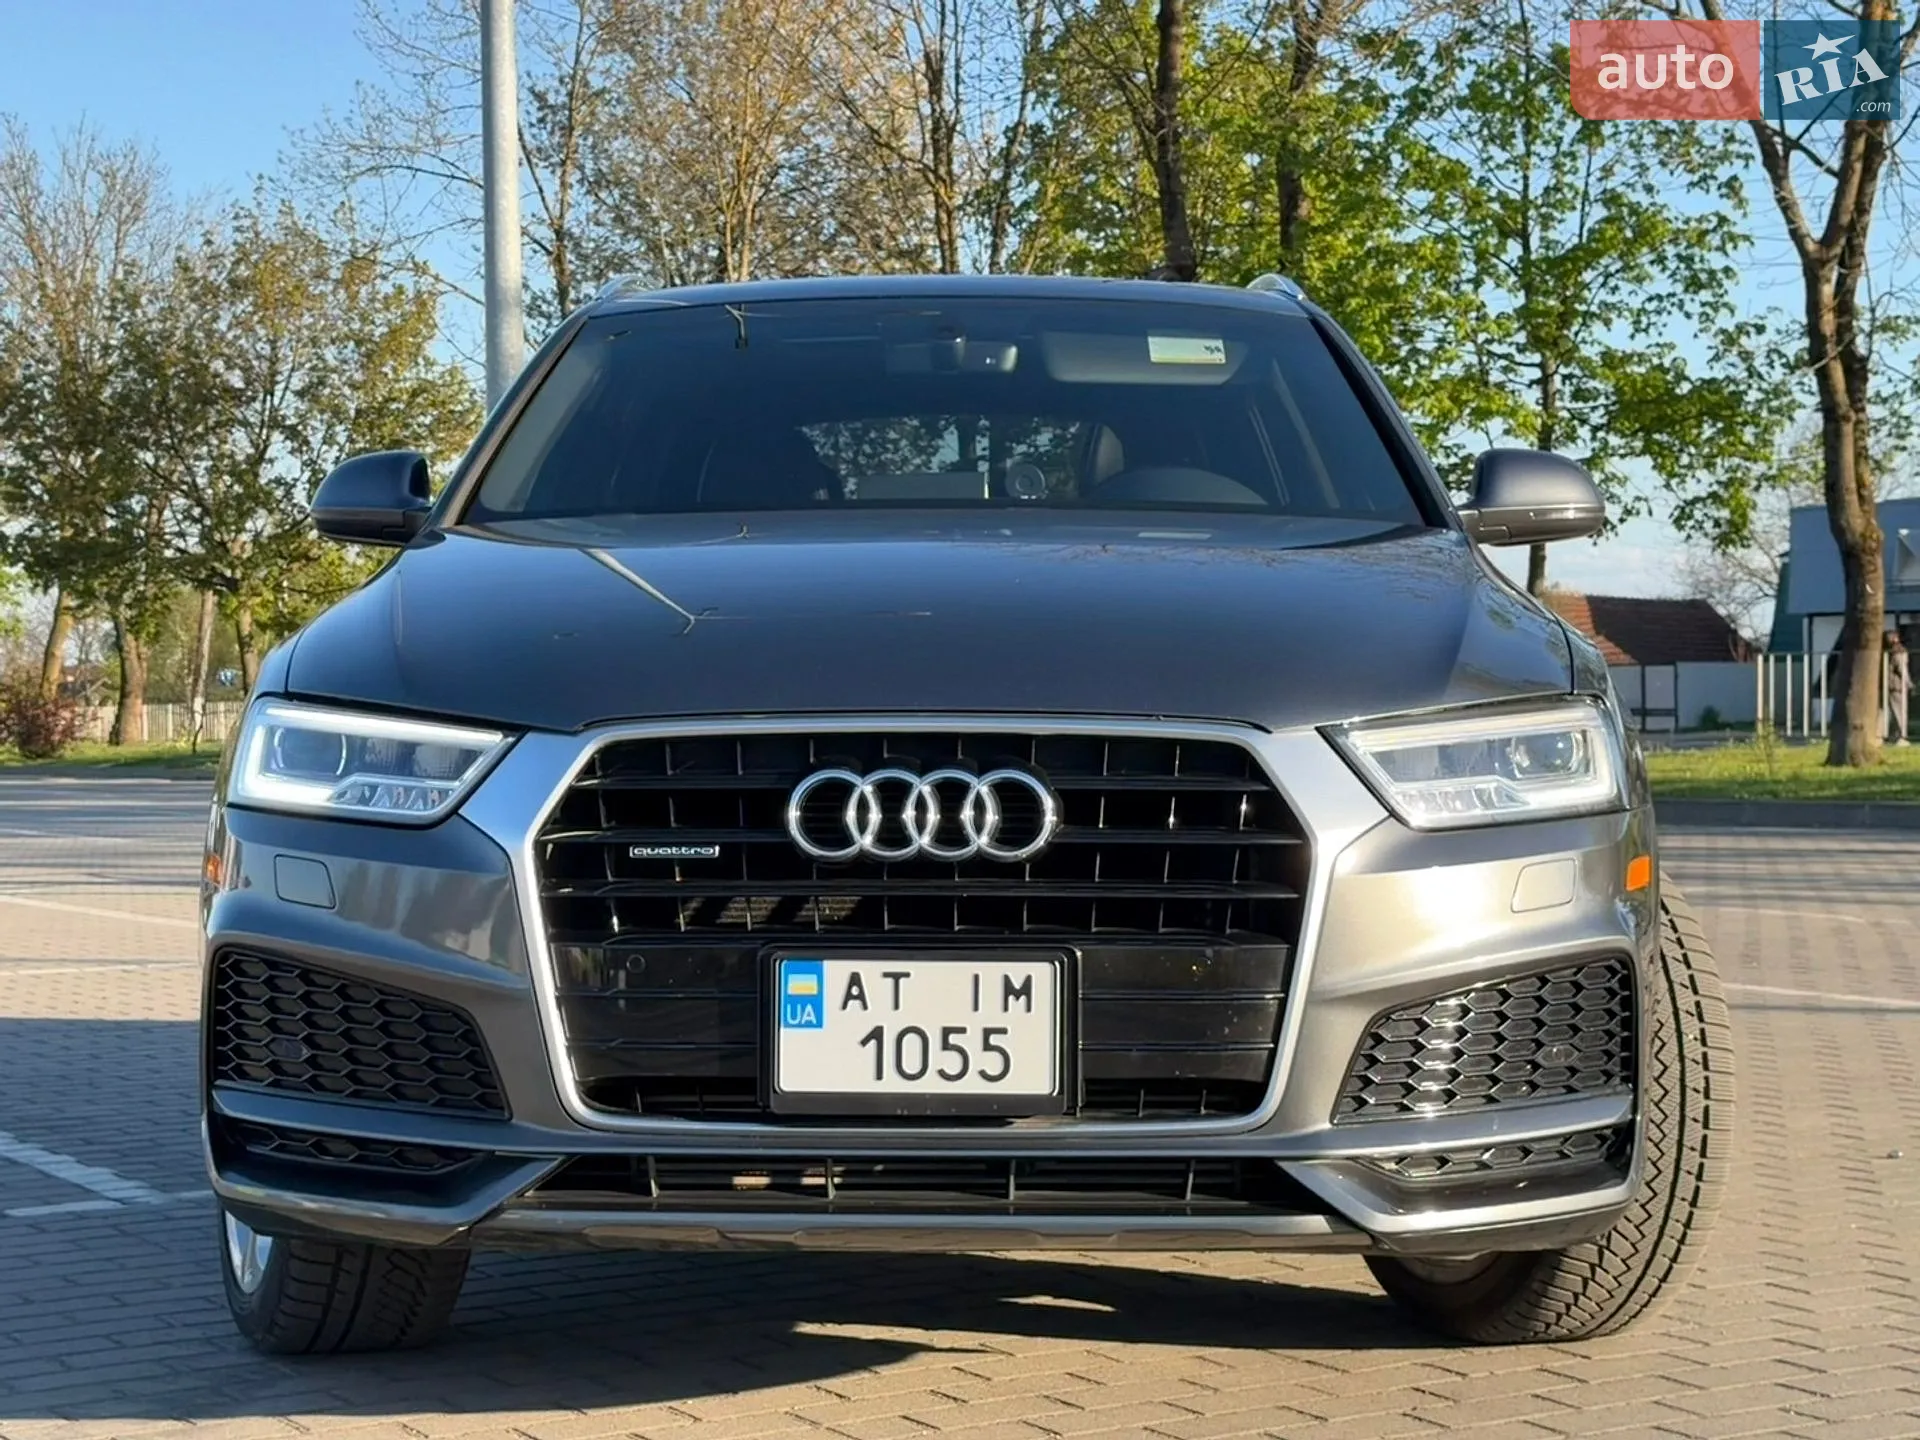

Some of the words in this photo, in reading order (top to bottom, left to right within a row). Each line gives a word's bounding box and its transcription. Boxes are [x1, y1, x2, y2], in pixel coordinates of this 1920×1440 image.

[633, 846, 714, 857] quattro
[841, 971, 912, 1011] AT
[972, 973, 1033, 1014] IM
[786, 1003, 817, 1025] UA
[859, 1025, 1012, 1083] 1055
